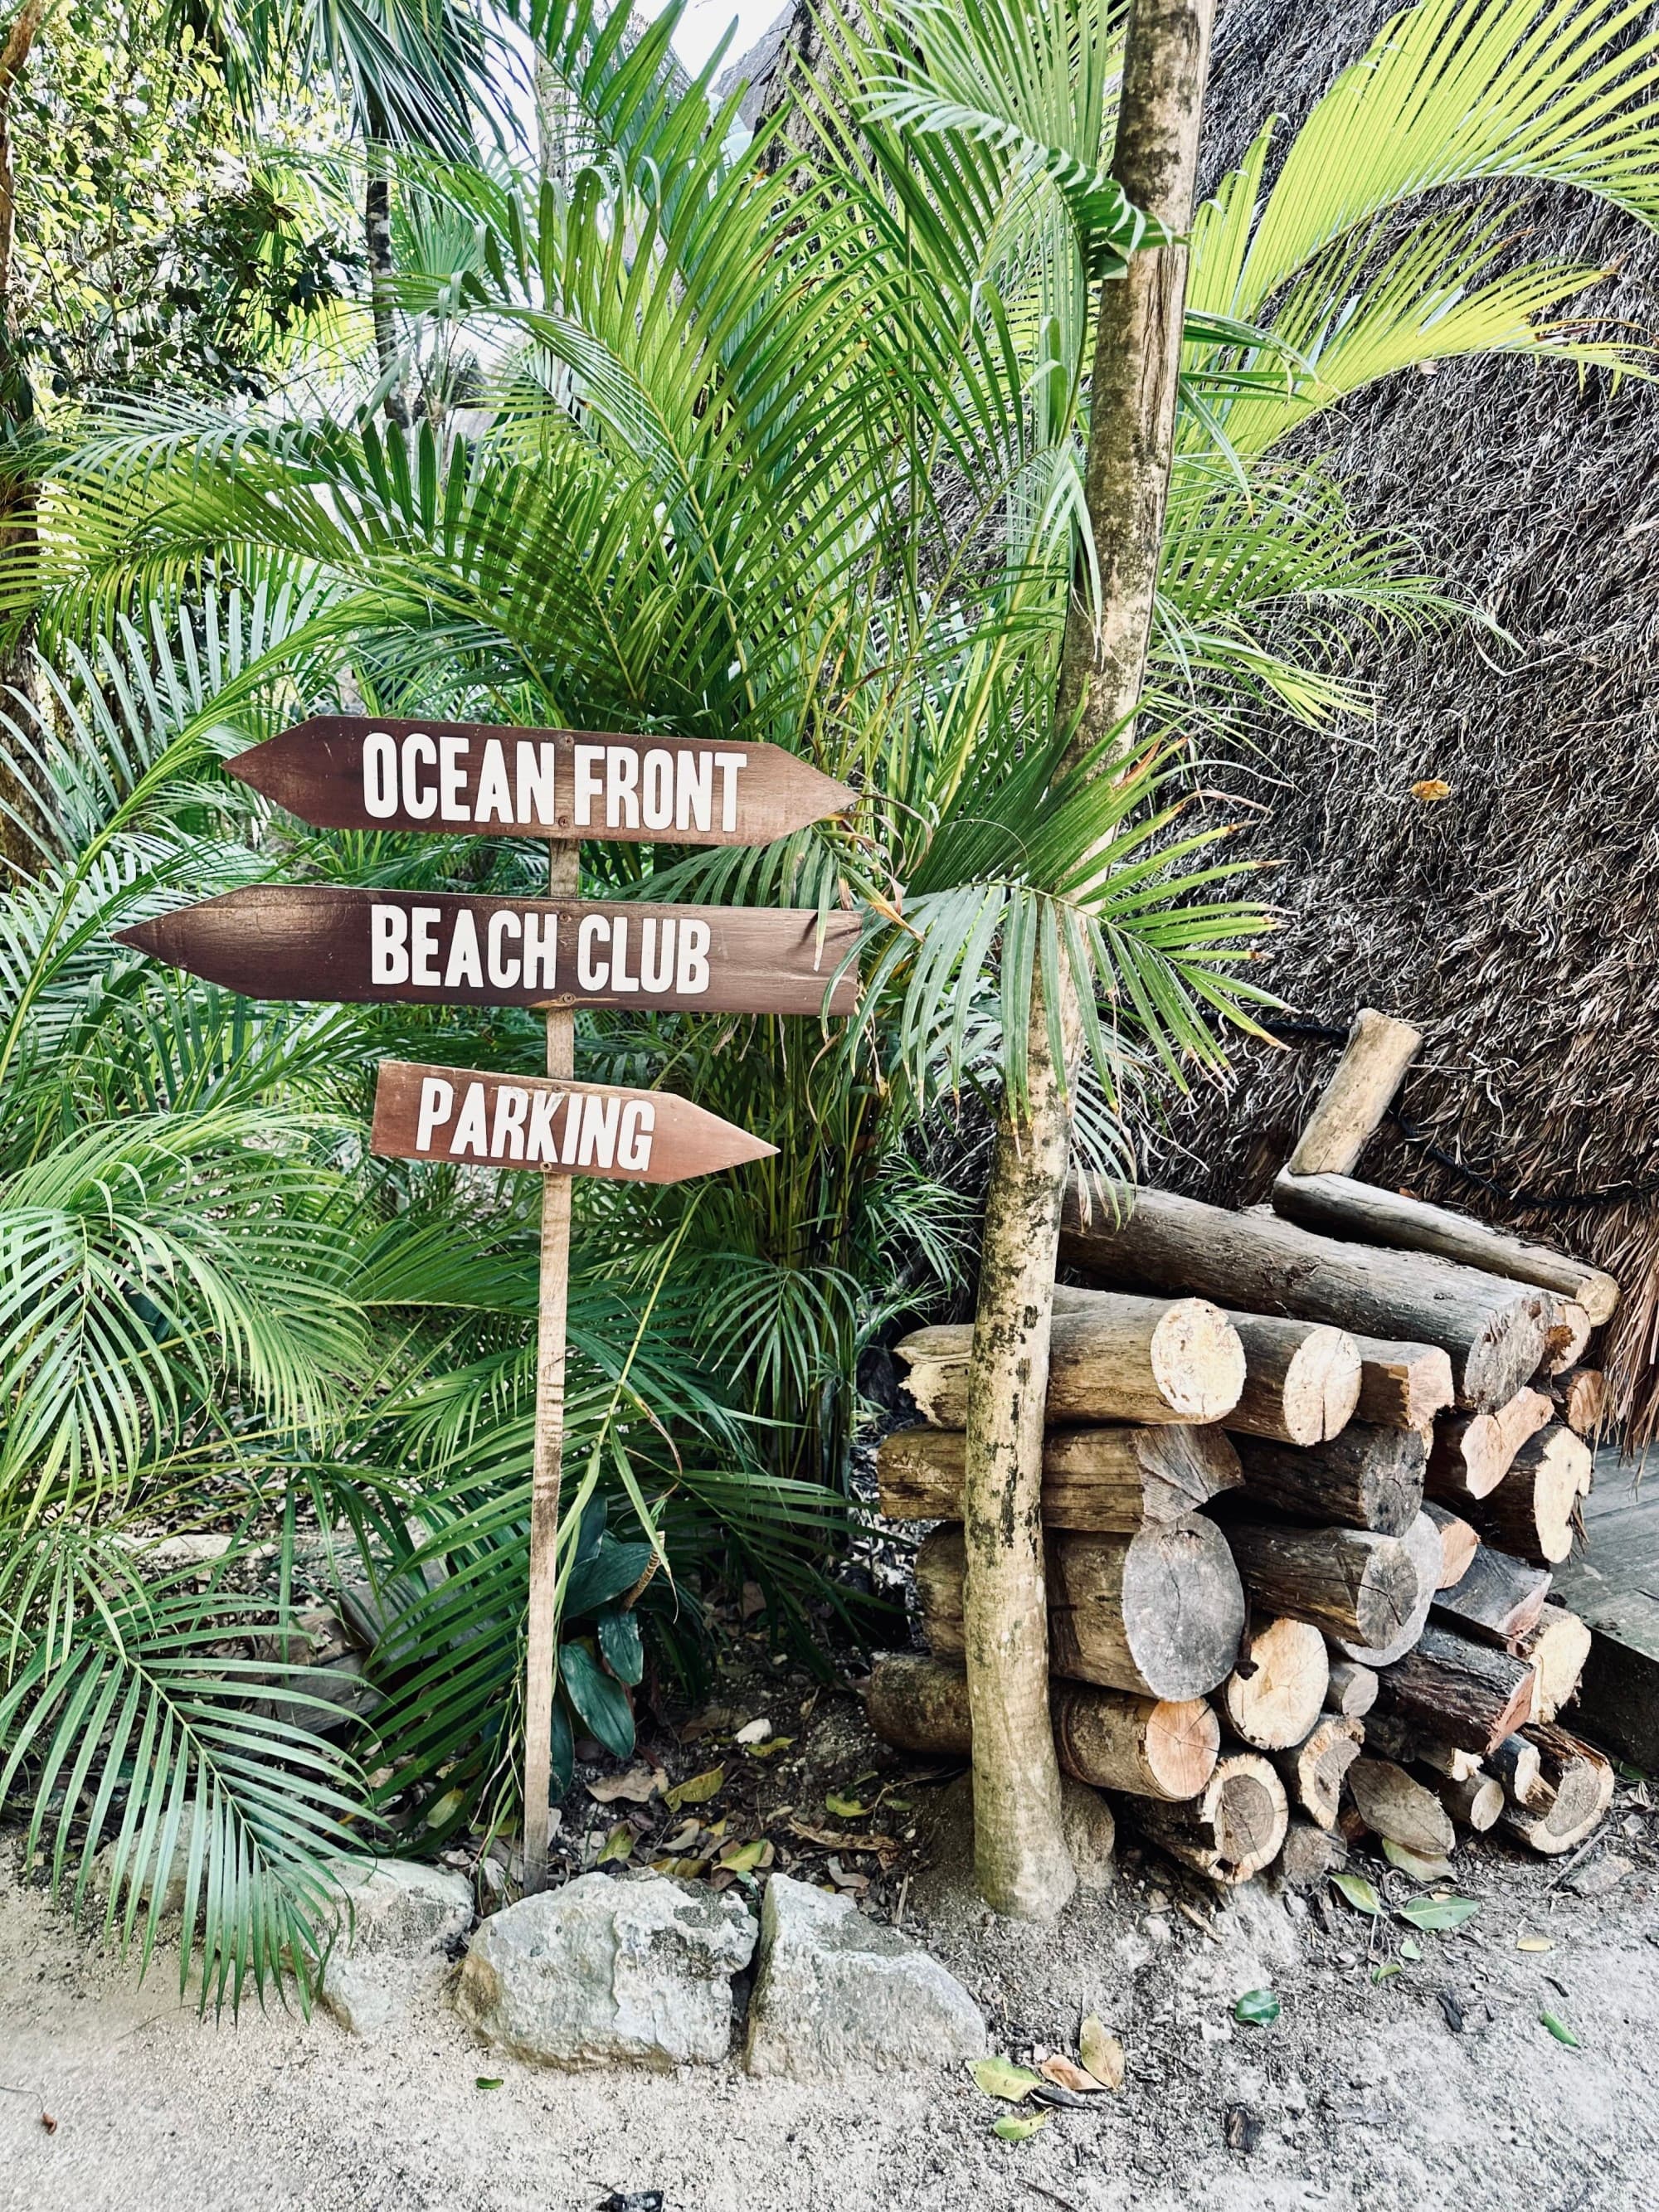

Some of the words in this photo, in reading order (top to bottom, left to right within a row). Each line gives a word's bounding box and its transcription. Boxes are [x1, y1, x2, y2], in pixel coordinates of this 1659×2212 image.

[362, 732, 556, 826] OCEAN
[573, 745, 747, 833] FRONT
[371, 904, 557, 989] BEACH
[577, 914, 711, 994] CLUB
[415, 1077, 656, 1172] PARKING
